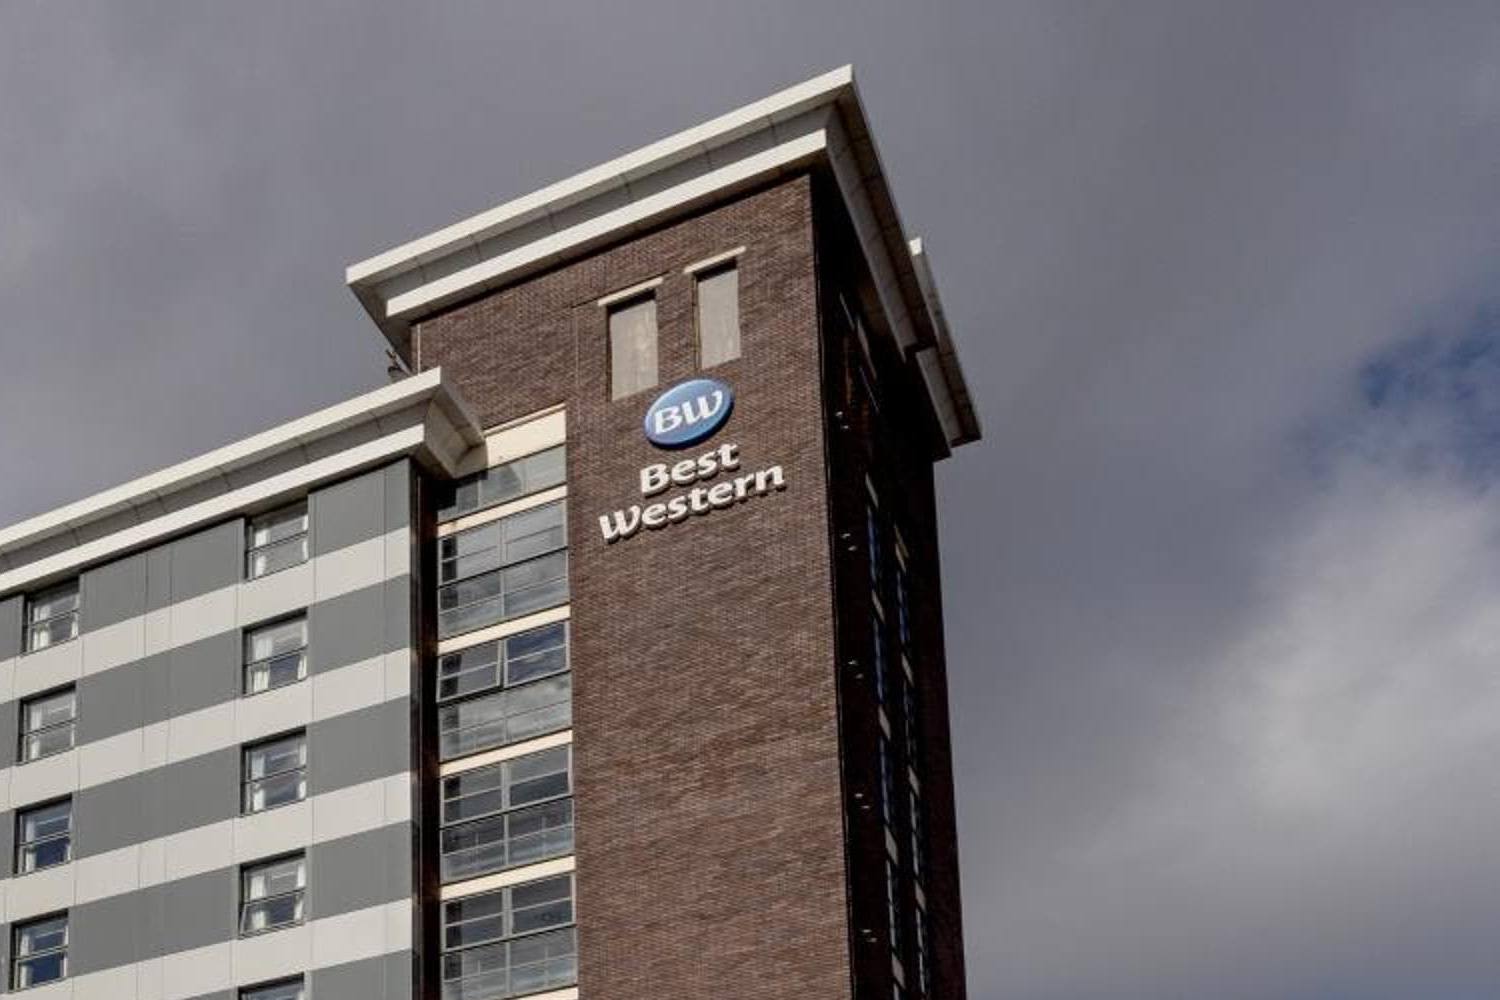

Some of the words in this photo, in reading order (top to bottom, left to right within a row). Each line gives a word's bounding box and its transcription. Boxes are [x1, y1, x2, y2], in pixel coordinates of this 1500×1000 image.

[654, 389, 723, 434] BW
[640, 442, 739, 496] Best
[599, 464, 785, 542] Western
